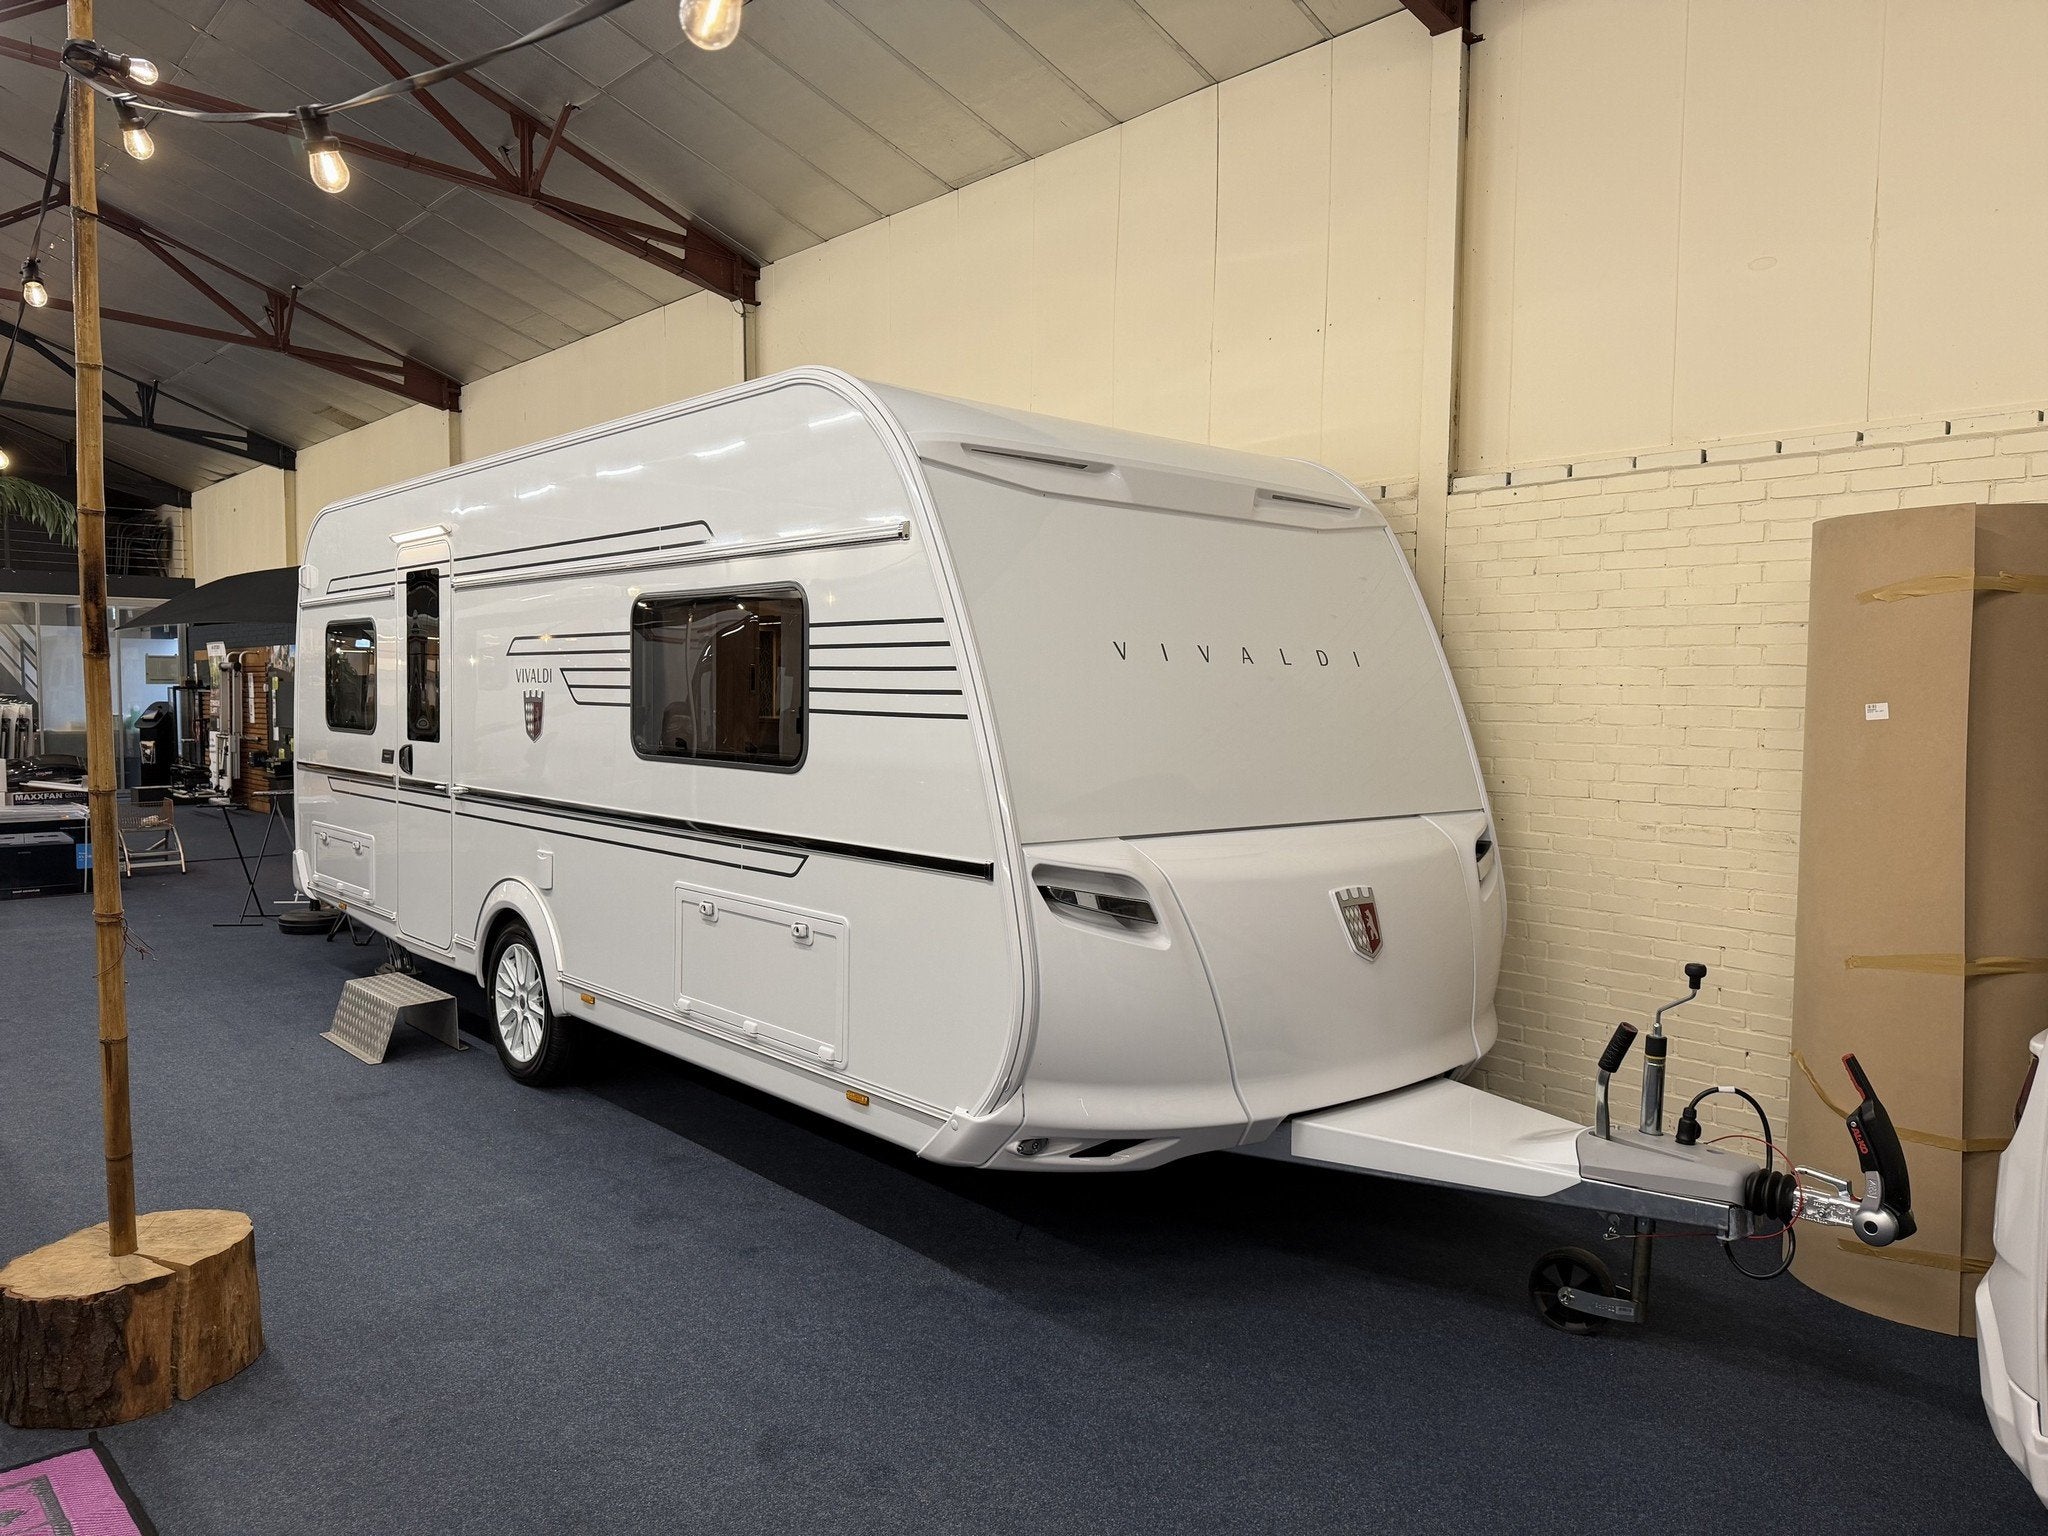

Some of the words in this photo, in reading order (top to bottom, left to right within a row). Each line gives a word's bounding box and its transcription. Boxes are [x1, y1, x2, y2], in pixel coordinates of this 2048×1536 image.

[1112, 640, 1361, 668] VIVALDI
[515, 668, 553, 684] VIVALDI
[15, 792, 63, 801] MAXXFAN
